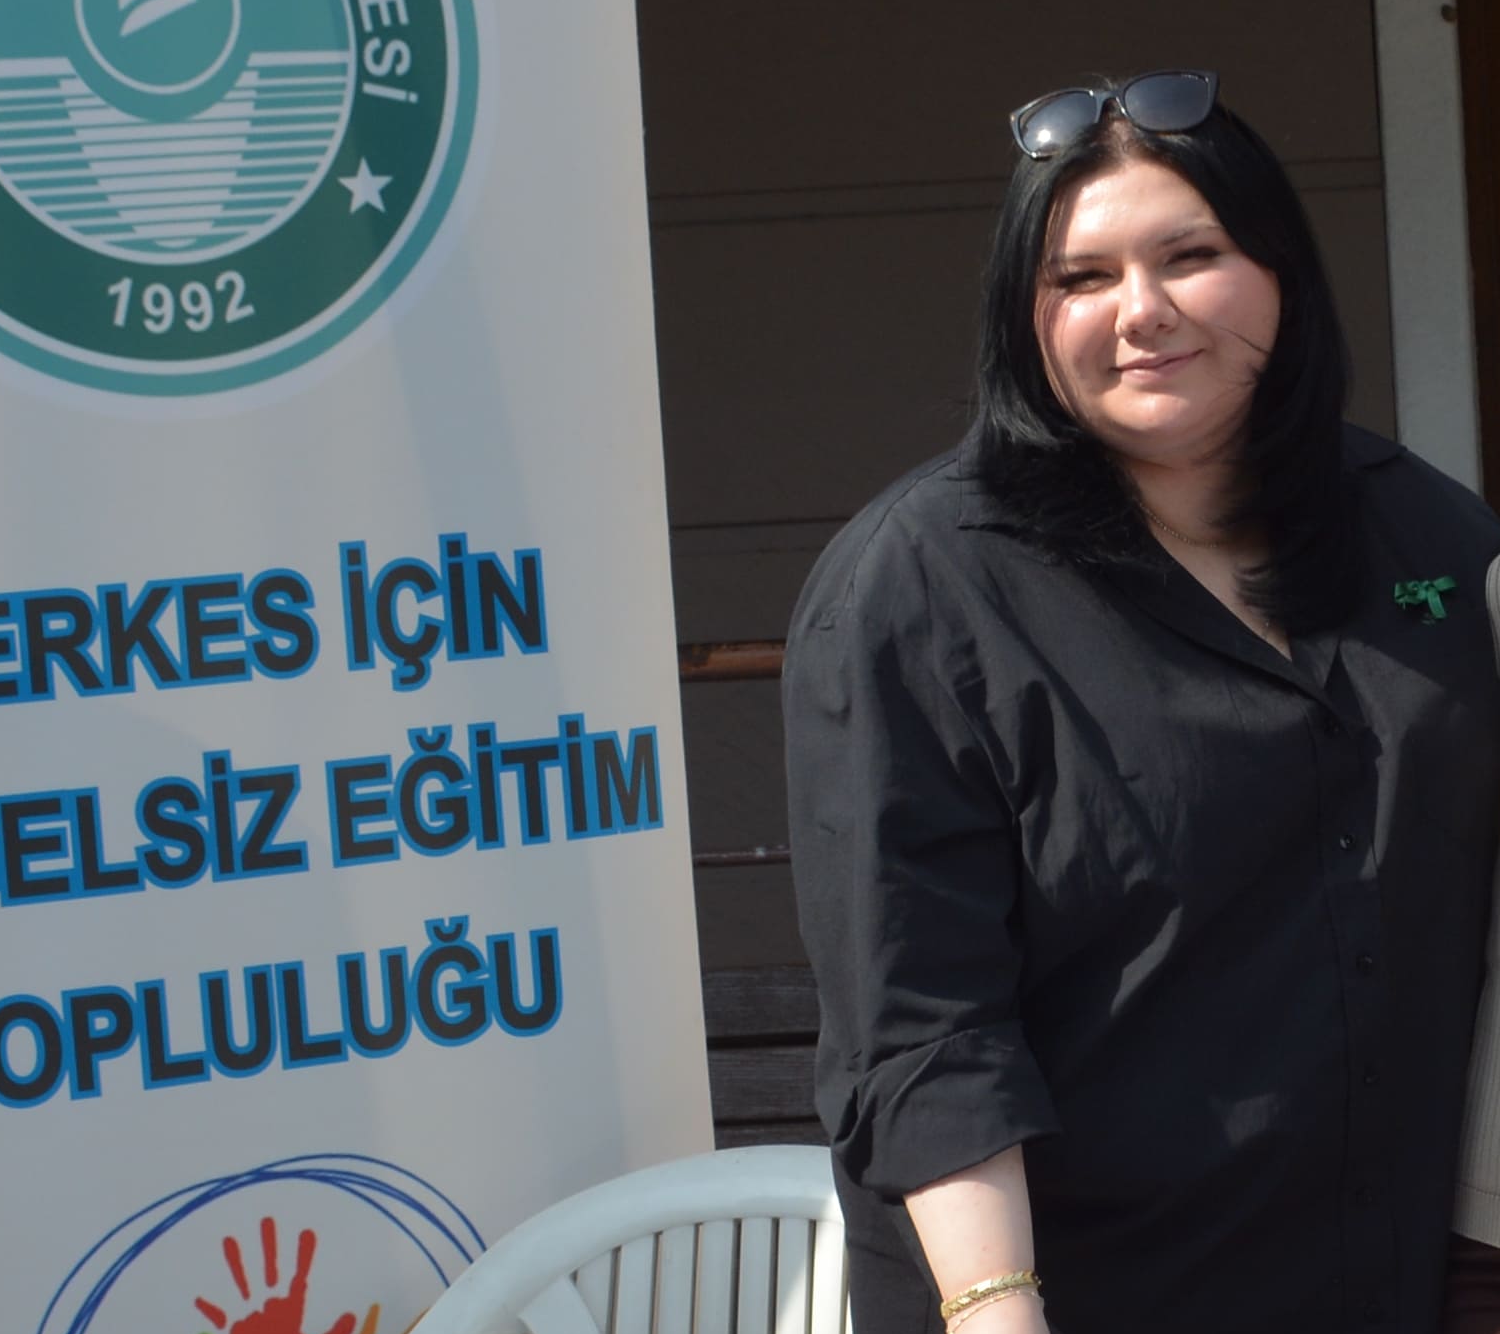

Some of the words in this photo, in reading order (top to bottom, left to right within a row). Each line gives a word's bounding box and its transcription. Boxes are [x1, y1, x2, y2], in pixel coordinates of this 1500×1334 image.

[107, 270, 255, 334] 1992
[338, 533, 549, 691] İÇİN
[325, 712, 664, 868] EĞİTİM
